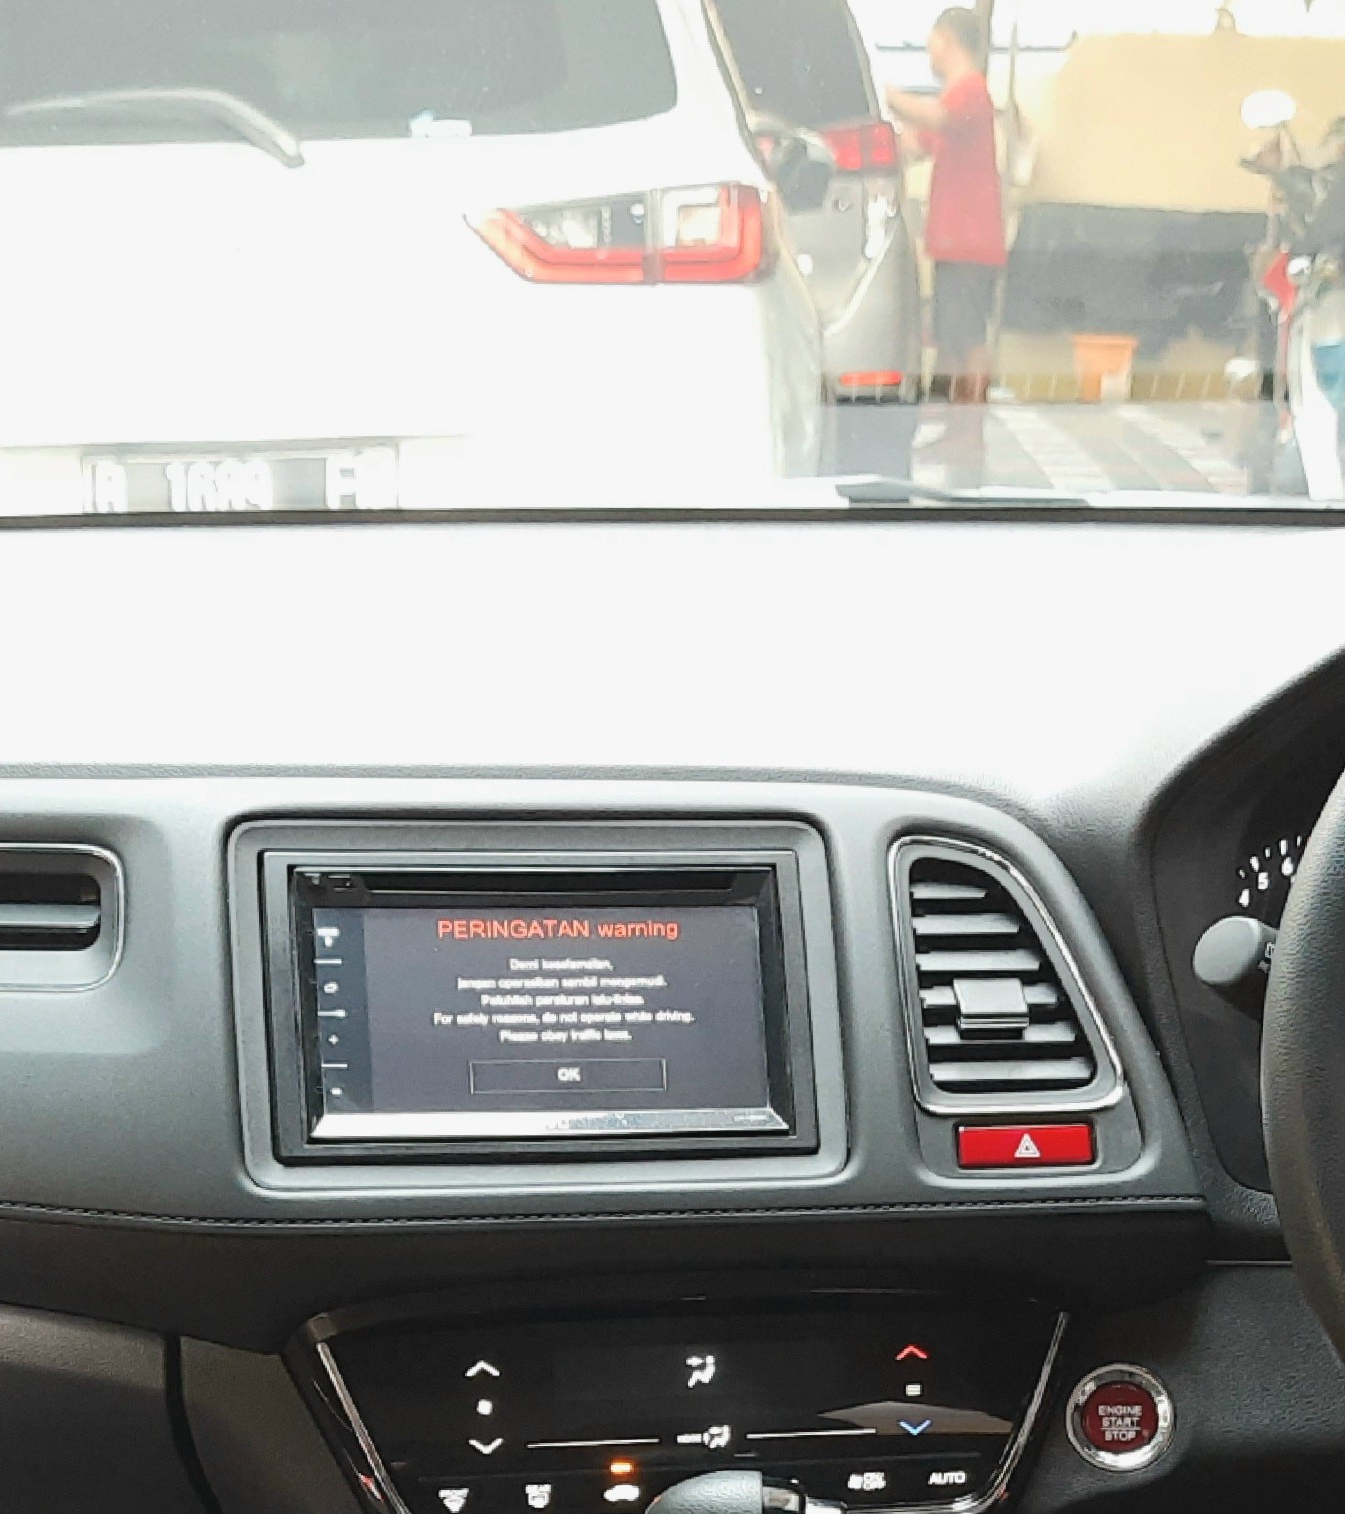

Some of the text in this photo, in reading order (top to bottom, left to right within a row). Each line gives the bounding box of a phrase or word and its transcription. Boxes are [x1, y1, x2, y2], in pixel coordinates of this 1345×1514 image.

[437, 919, 679, 941] PERINGATAN warning
[434, 1012, 454, 1026] For
[558, 1066, 581, 1082] OK
[1098, 1405, 1142, 1416] ENGINE
[1102, 1417, 1140, 1427] START
[1104, 1431, 1136, 1441] STOP
[927, 1471, 966, 1485] AUTO
